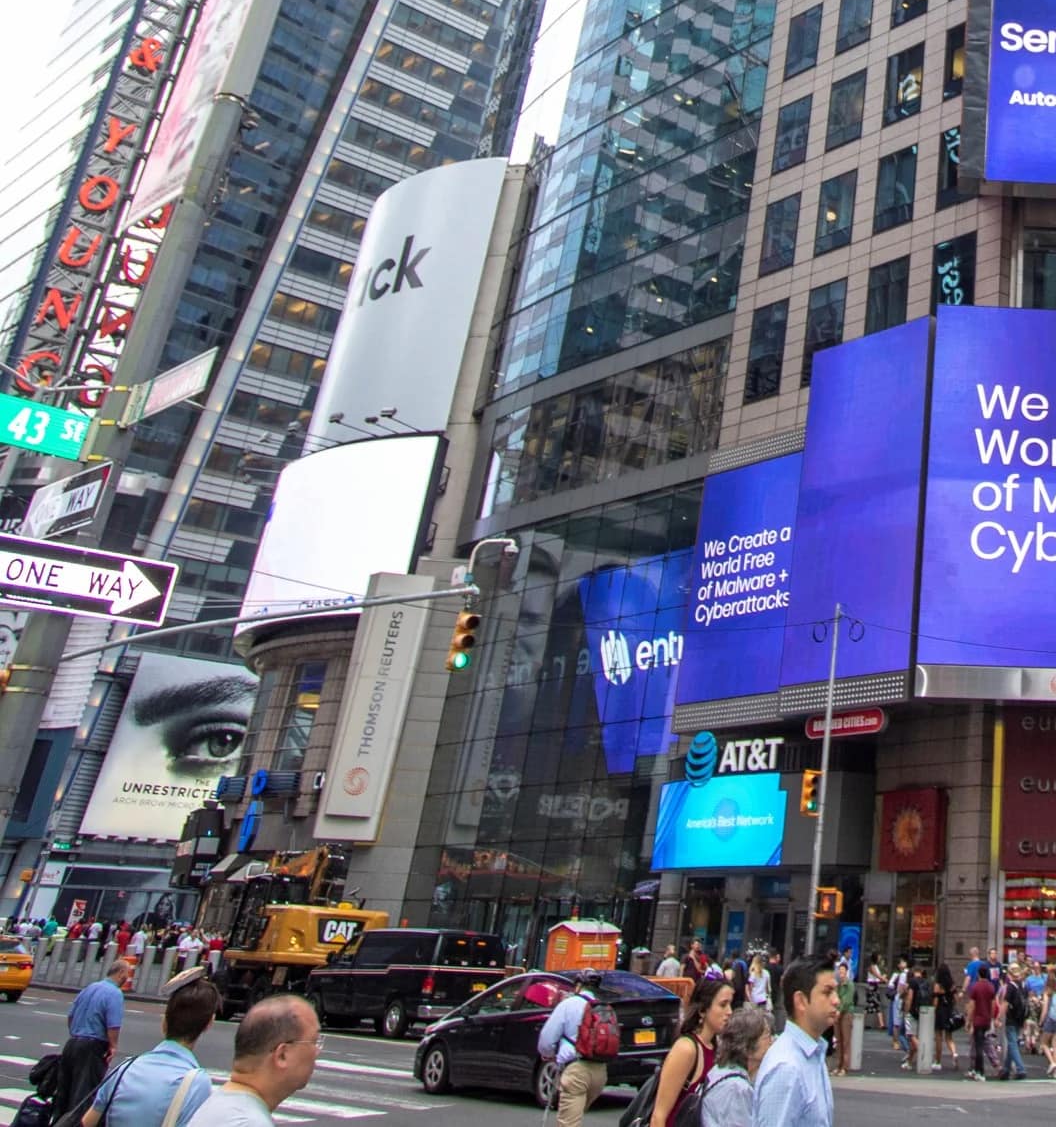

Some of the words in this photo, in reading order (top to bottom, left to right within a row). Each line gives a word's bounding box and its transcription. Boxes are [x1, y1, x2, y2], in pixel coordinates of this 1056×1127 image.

[129, 37, 162, 72] &
[976, 384, 1049, 422] We
[8, 407, 50, 445] 43
[66, 485, 96, 512] WAY
[972, 474, 1020, 513] of
[704, 540, 726, 558] We
[728, 529, 778, 553] Create
[780, 526, 792, 542] a
[7, 558, 63, 587] ONE
[88, 571, 143, 600] WAY
[701, 554, 742, 579] World
[743, 551, 775, 571] Free
[697, 580, 714, 601] of
[714, 572, 776, 598] Malware
[778, 569, 789, 582] +
[695, 589, 790, 626] Cyberattacks
[357, 681, 386, 757] THOMSON
[377, 611, 404, 677] REUTERS
[719, 738, 784, 774] AT&T
[122, 781, 217, 800] UNRESTRICTE
[737, 813, 775, 826] Network
[323, 920, 358, 942] CAT
